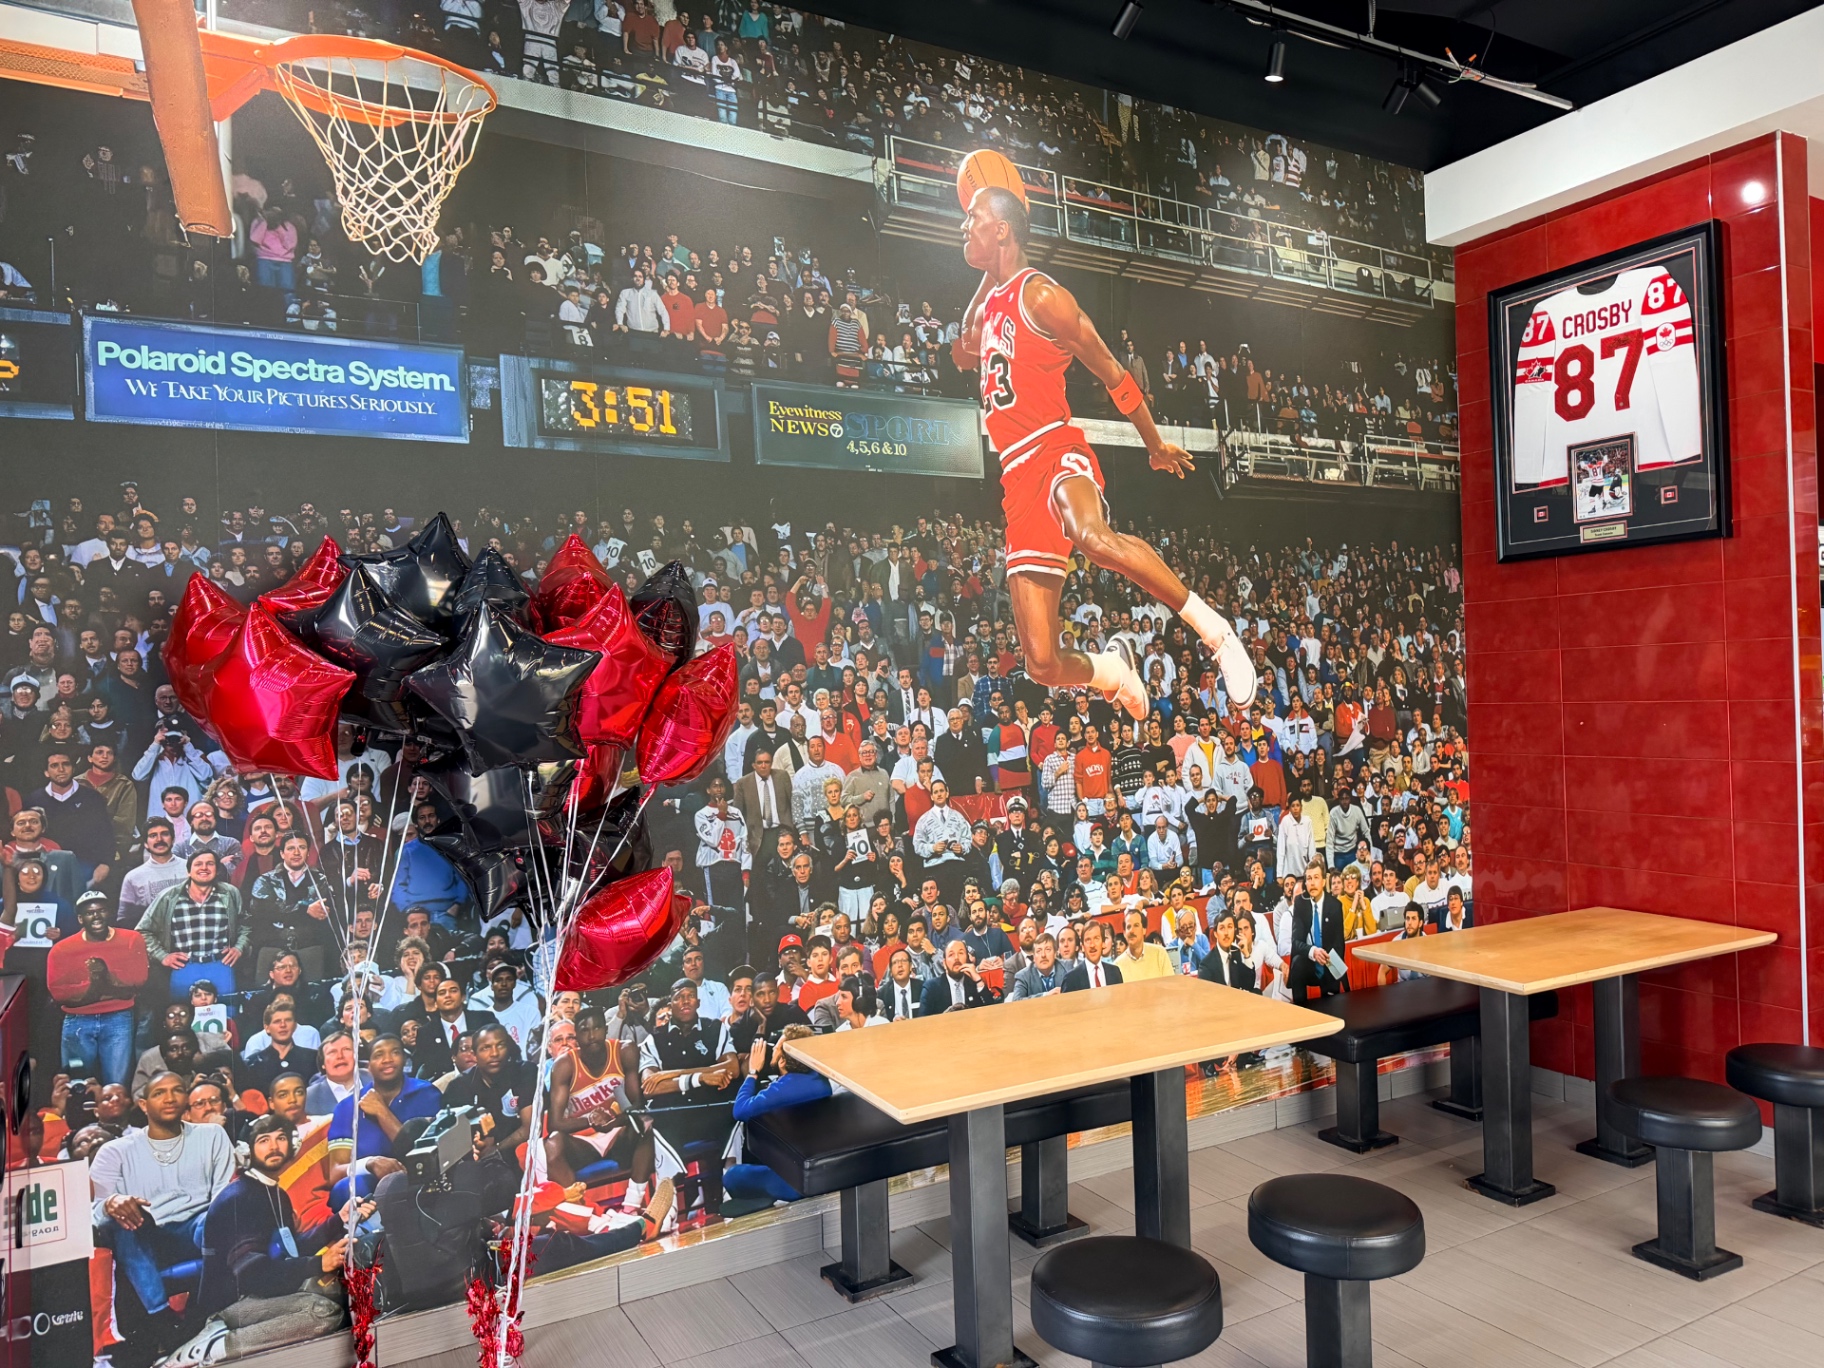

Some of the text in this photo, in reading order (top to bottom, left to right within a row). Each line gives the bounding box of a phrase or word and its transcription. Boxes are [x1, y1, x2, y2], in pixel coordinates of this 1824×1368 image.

[1647, 280, 1683, 309] 87
[1522, 314, 1549, 343] 87
[1562, 299, 1633, 340] CROSBY
[97, 340, 226, 376] Polaroid
[231, 351, 345, 384] Spectra
[1554, 328, 1644, 422] 87
[570, 380, 678, 434] 3:51
[768, 400, 842, 421] Eyewitness
[770, 419, 829, 437] NEWS
[893, 443, 907, 456] 10
[606, 546, 619, 558] 10
[641, 557, 656, 570] 10
[15, 917, 52, 939] 10
